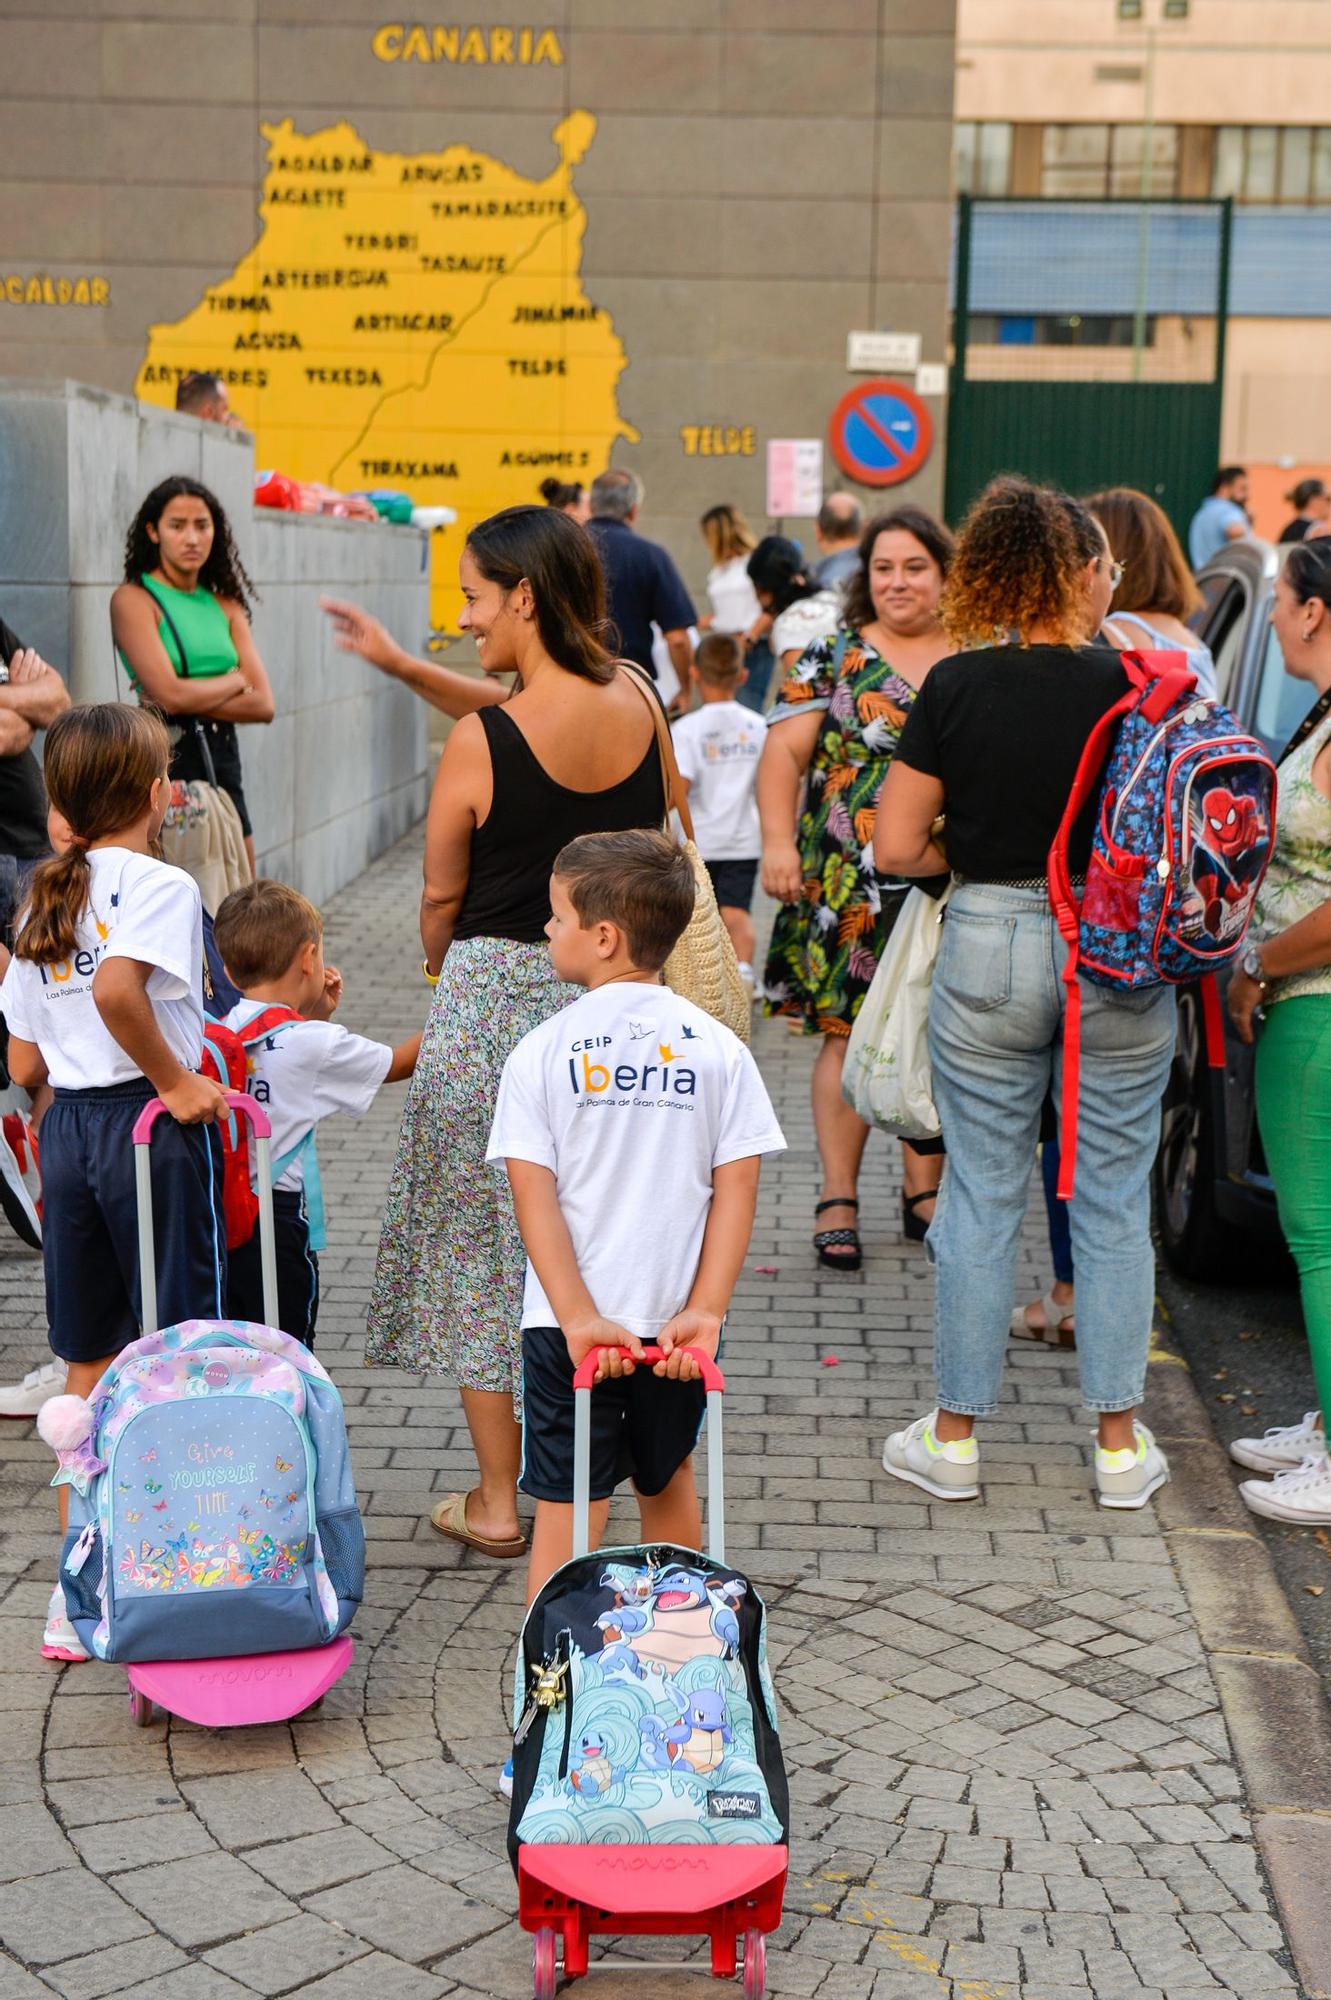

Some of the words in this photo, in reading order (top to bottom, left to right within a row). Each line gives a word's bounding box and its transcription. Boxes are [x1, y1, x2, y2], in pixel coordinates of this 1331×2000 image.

[372, 23, 564, 66] CANARIA
[209, 296, 271, 314] TIRMA
[305, 368, 383, 387] TEXEDA
[508, 359, 568, 377] TELDE
[680, 424, 757, 457] TELDE
[46, 991, 60, 1000] Las
[60, 986, 84, 997] Palmas
[571, 1035, 613, 1053] CEIP
[568, 1053, 697, 1096] Iberia
[619, 1098, 631, 1107] de
[632, 1097, 655, 1108] Gran
[657, 1098, 695, 1112] Canaria
[187, 1442, 235, 1465] Give
[168, 1461, 257, 1491] YOURSELF
[195, 1490, 230, 1516] TIME
